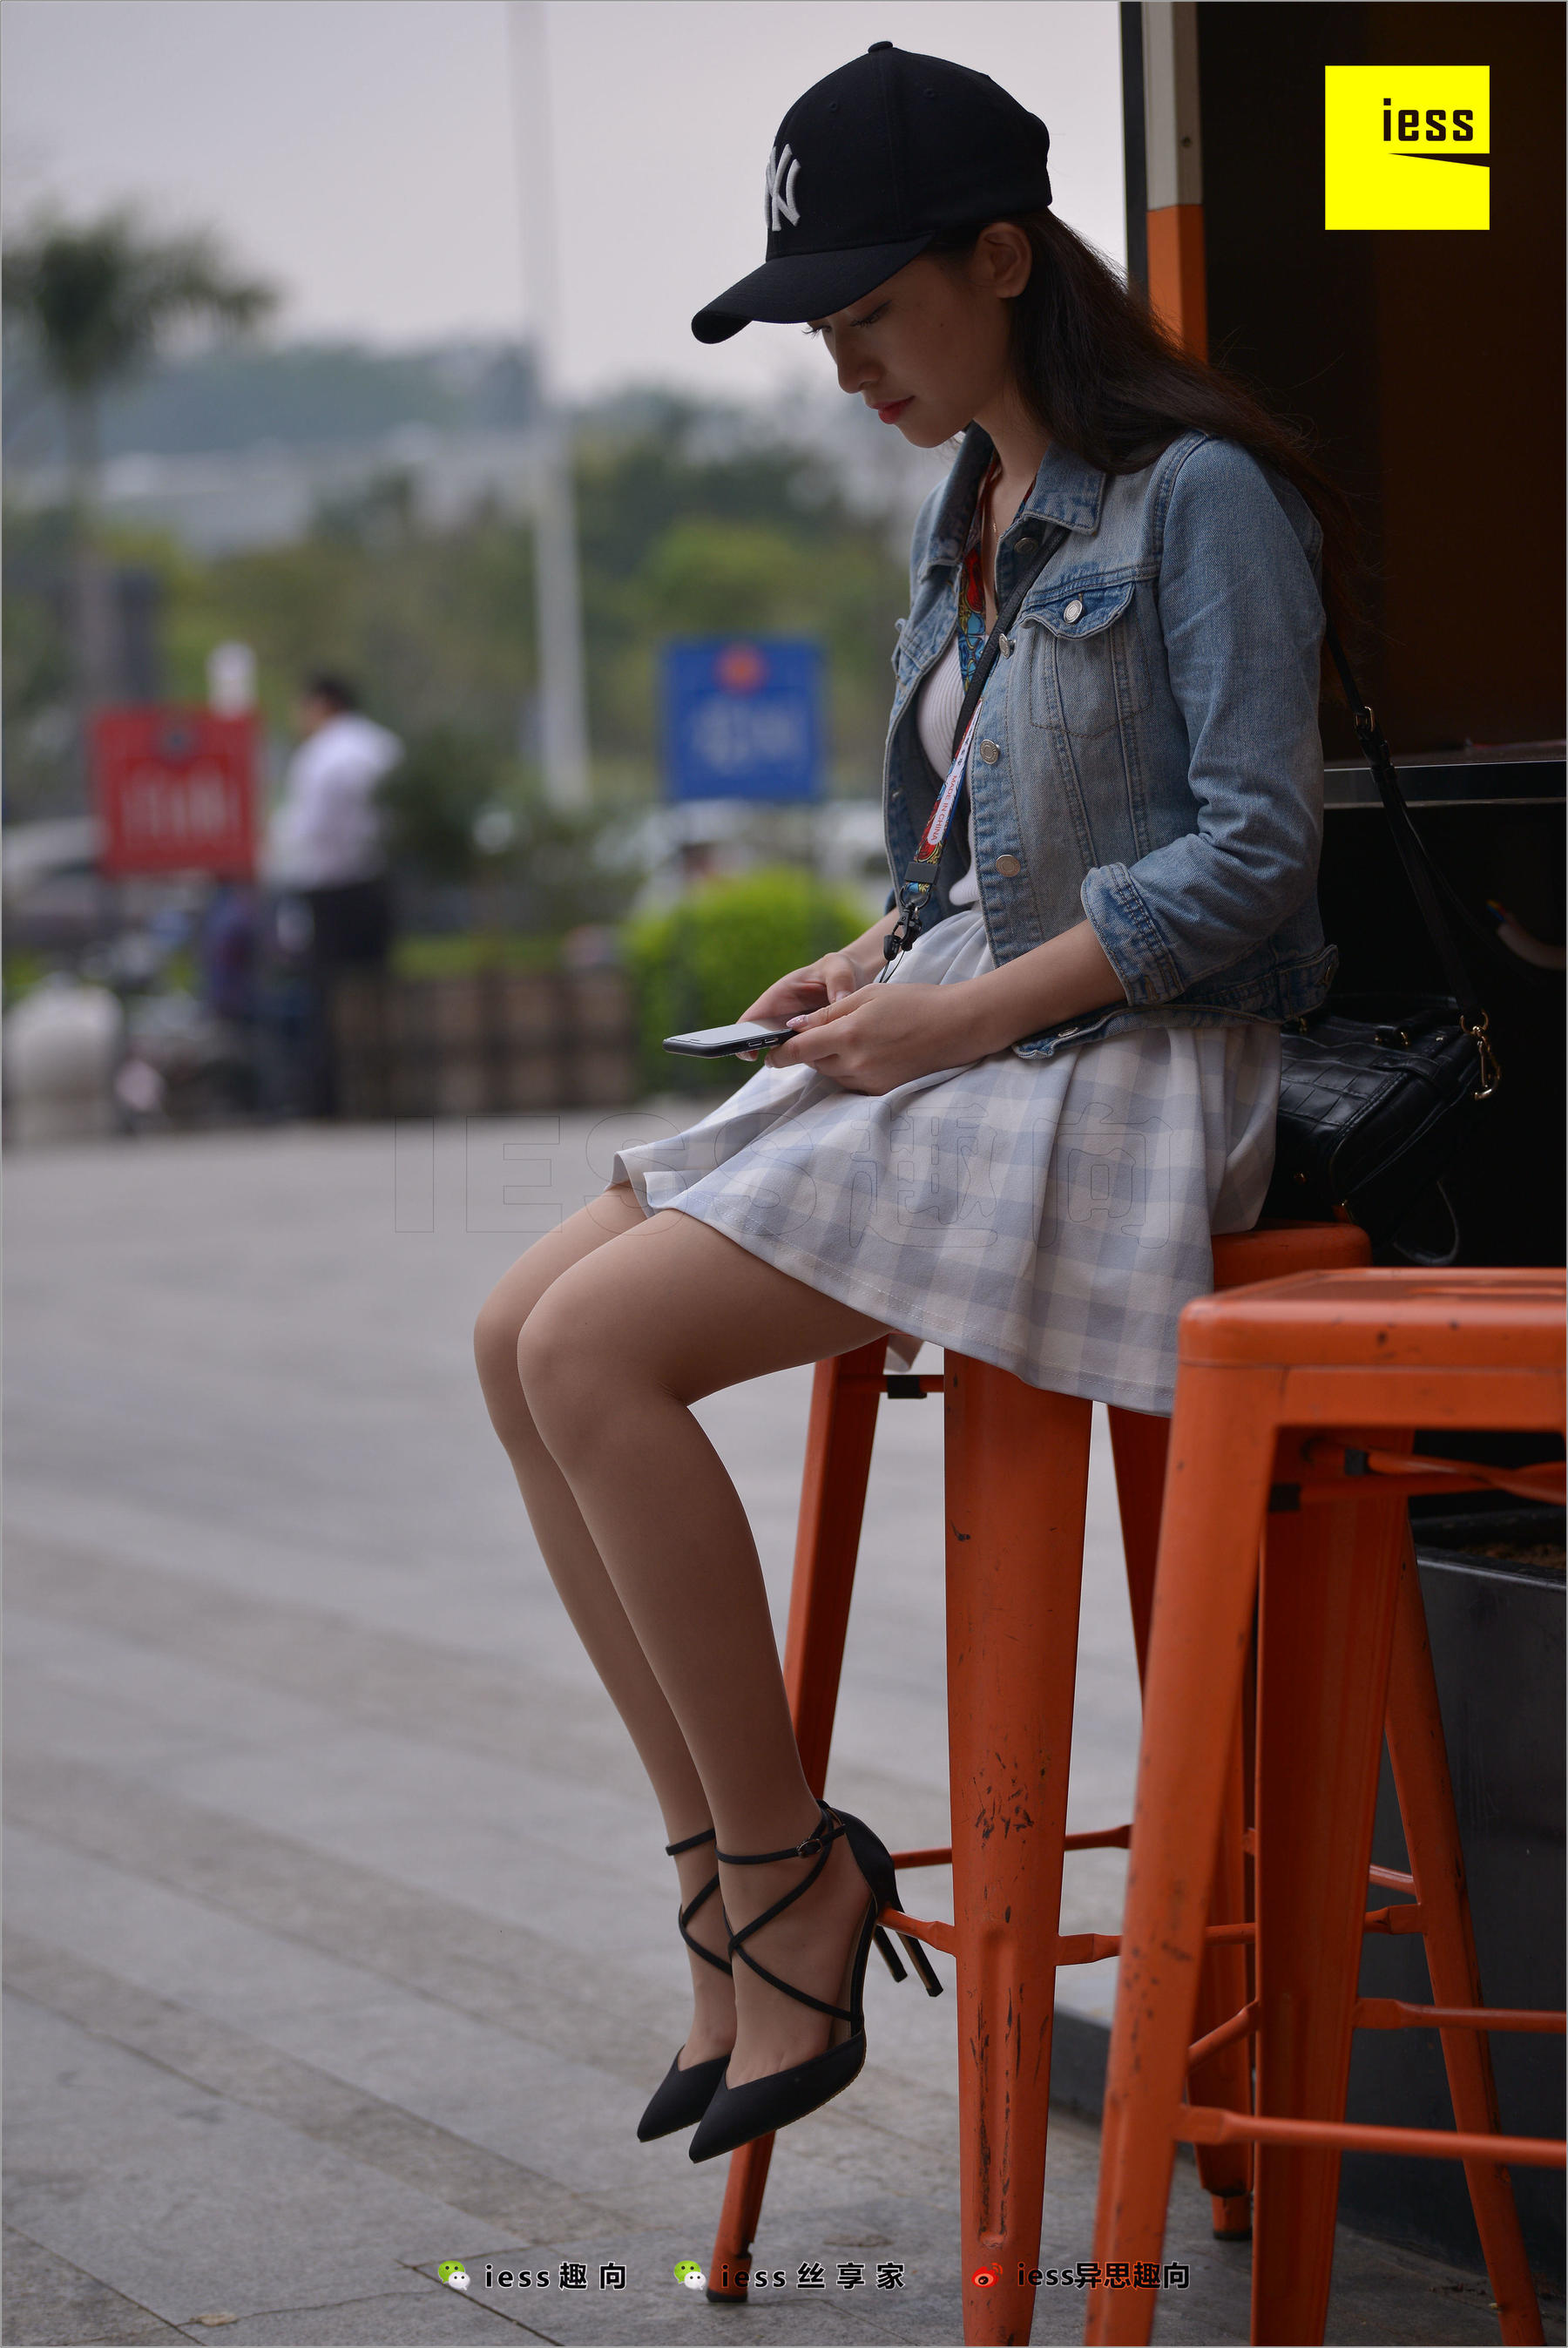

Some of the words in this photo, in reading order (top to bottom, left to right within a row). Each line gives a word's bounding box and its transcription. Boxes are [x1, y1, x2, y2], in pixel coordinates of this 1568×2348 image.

[944, 775, 957, 801] MADE
[941, 802, 949, 812] IN
[930, 813, 945, 841] CHINA
